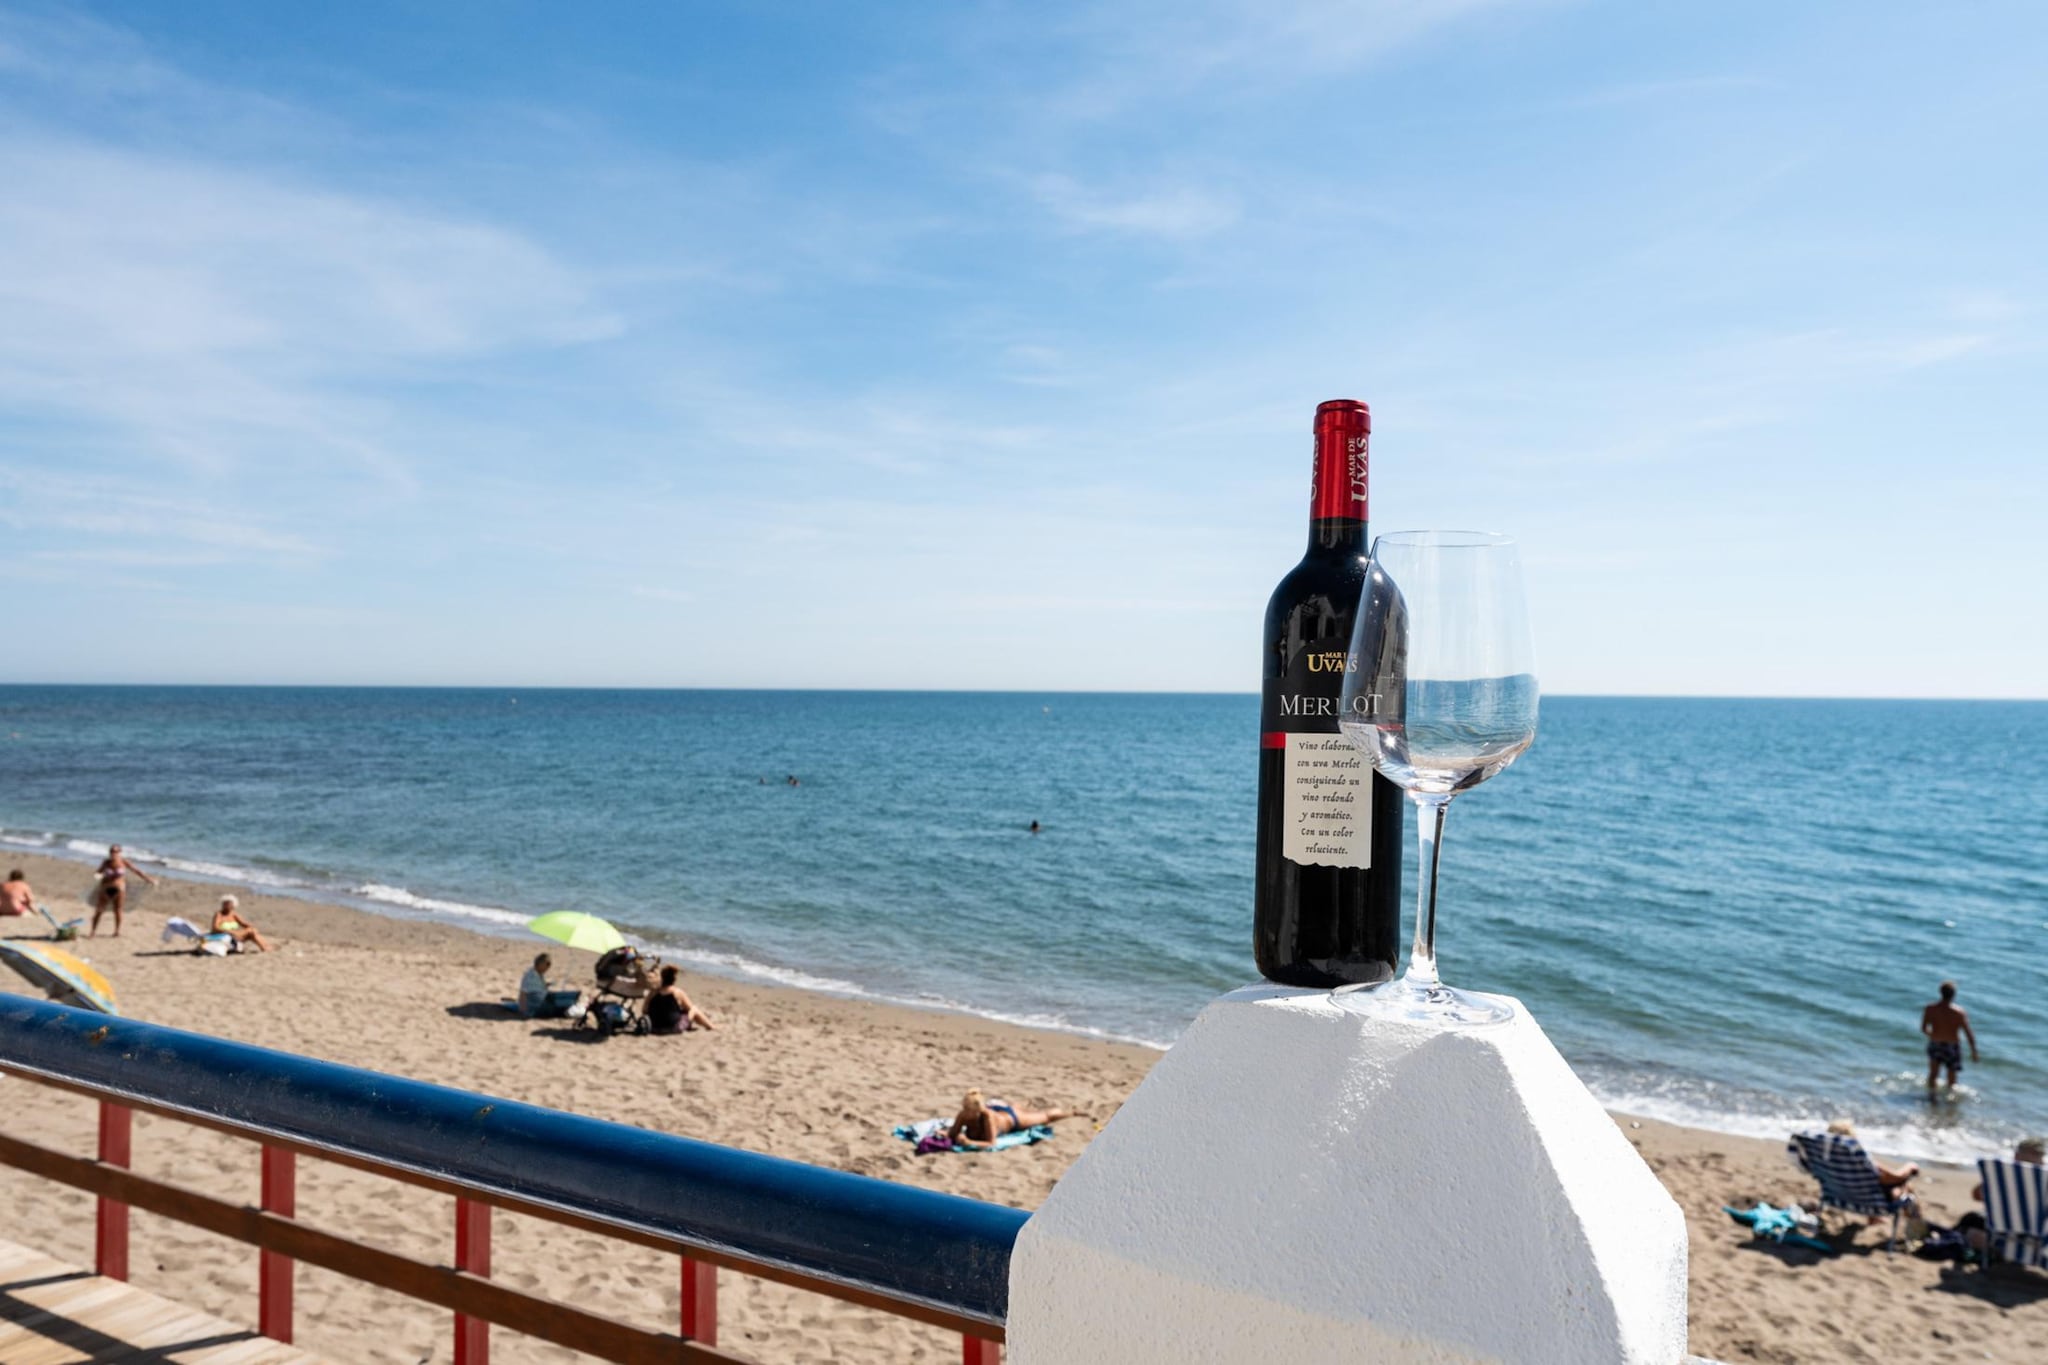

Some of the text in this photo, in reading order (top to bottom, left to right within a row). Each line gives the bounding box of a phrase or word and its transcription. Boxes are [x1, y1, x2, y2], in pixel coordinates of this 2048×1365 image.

[1349, 438, 1356, 452] DE
[1350, 437, 1368, 502] UVAS
[1307, 654, 1357, 672] UVAS
[1280, 693, 1383, 717] MERLOT
[1298, 739, 1356, 751] Vino elabora
[1297, 757, 1360, 769] con uva Merlot
[1296, 774, 1360, 789] consiguiendo un
[1302, 791, 1355, 803] vino redondo
[1298, 808, 1353, 823] y aromático.
[1318, 829, 1330, 837] un
[1332, 826, 1354, 838] color
[1304, 842, 1349, 855] reluciente.
